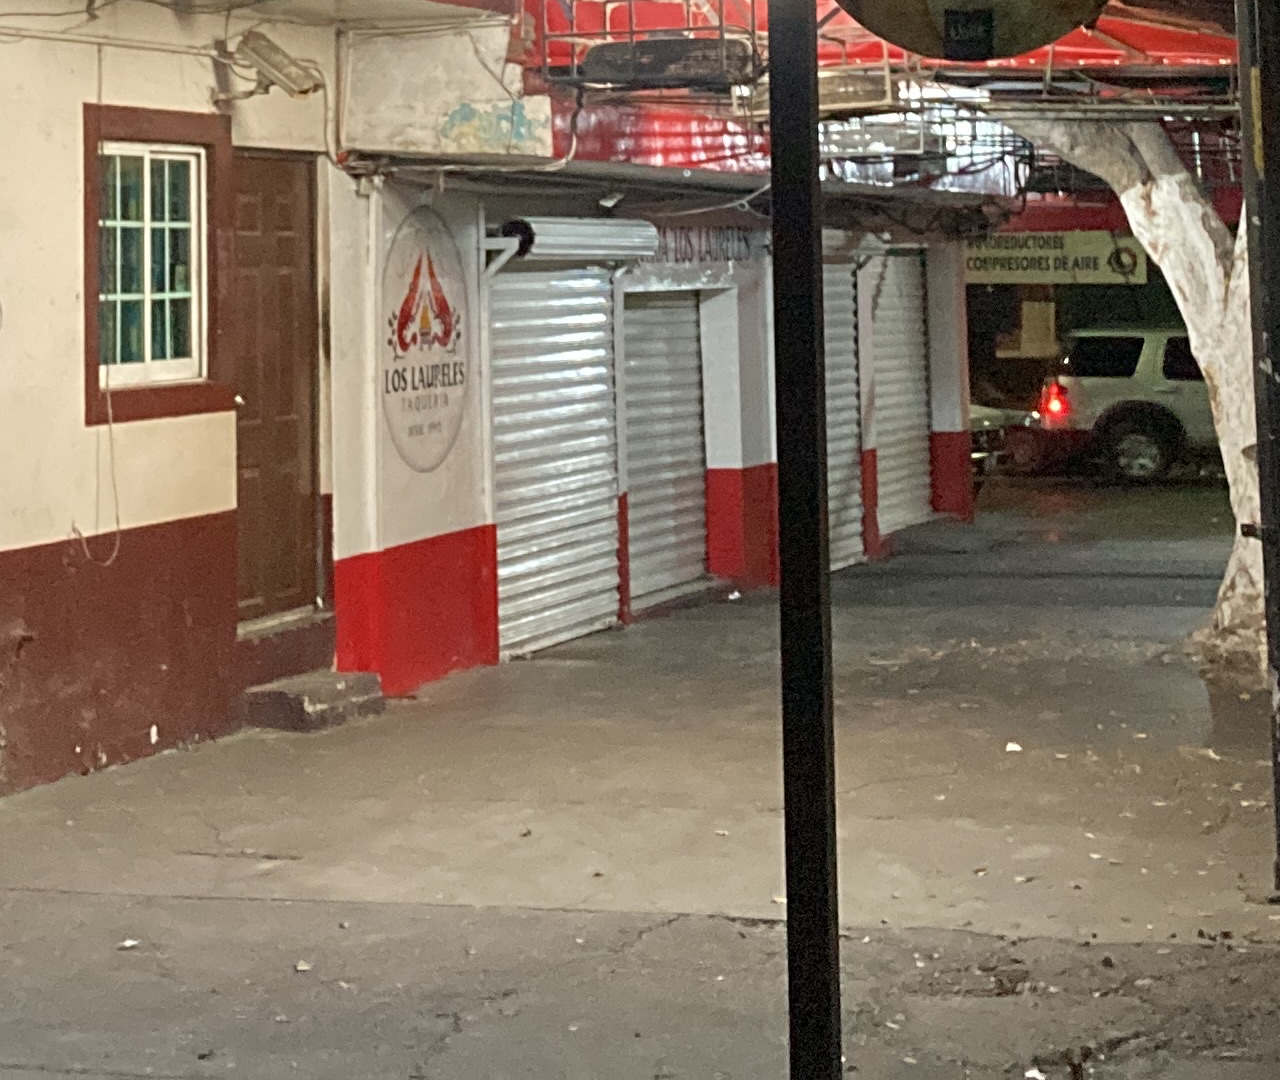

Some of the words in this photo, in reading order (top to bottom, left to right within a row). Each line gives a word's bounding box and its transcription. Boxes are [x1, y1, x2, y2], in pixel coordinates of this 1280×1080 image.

[966, 255, 1050, 271] COMPRESORES
[1053, 255, 1069, 271] DE
[1072, 255, 1100, 271] AIRE
[384, 366, 408, 395] LOS
[411, 361, 466, 392] LAURELES
